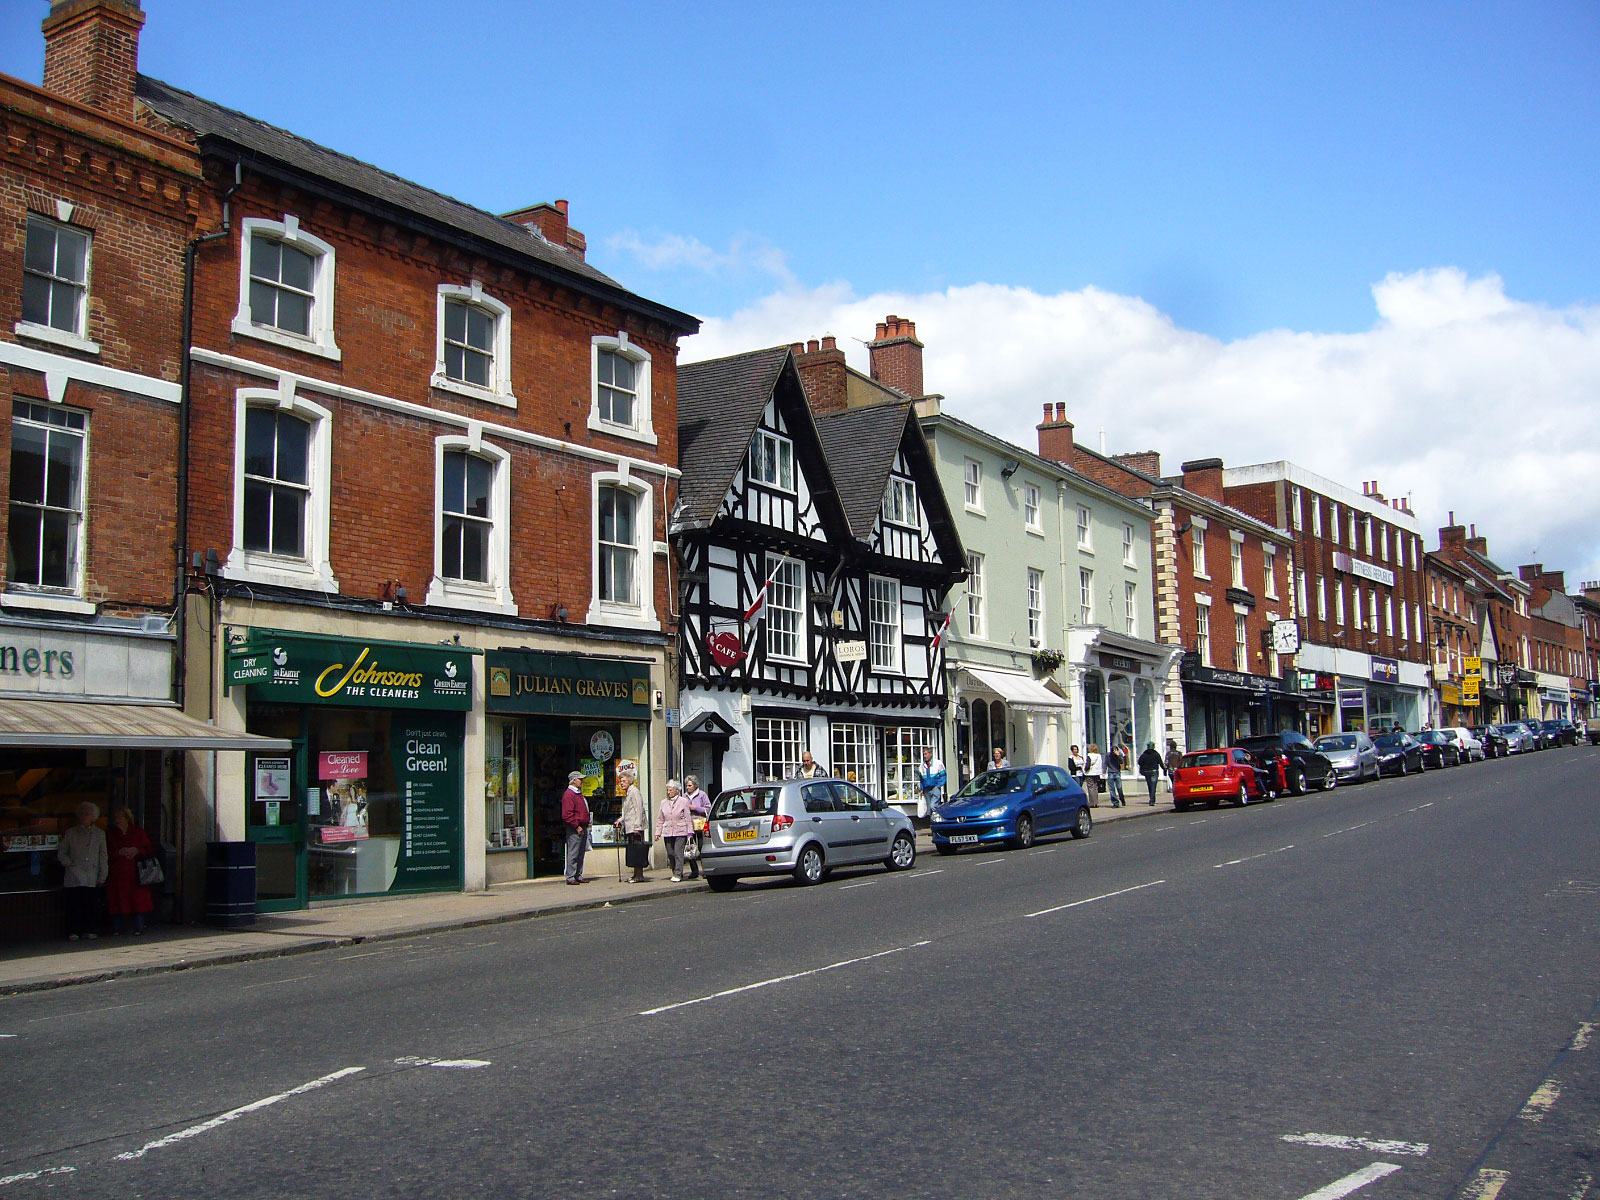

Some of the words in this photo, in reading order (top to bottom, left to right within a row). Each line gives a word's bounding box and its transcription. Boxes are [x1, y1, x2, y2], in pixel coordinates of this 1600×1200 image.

[1355, 561, 1372, 577] FITNESS
[1373, 567, 1393, 584] REPUBLIC
[716, 643, 736, 659] CAFE
[839, 645, 865, 653] LOROS
[0, 646, 73, 675] ners
[243, 658, 257, 667] DRY
[233, 667, 268, 679] CLEANING
[315, 647, 423, 698] Johnsons
[346, 686, 366, 696] THE
[369, 687, 419, 699] CLEANERS
[516, 674, 572, 695] JULIAN
[576, 679, 628, 698] GRAVES
[406, 740, 441, 754] Clean
[327, 754, 361, 765] Cleaned
[406, 757, 448, 771] Green!
[340, 763, 360, 774] Love
